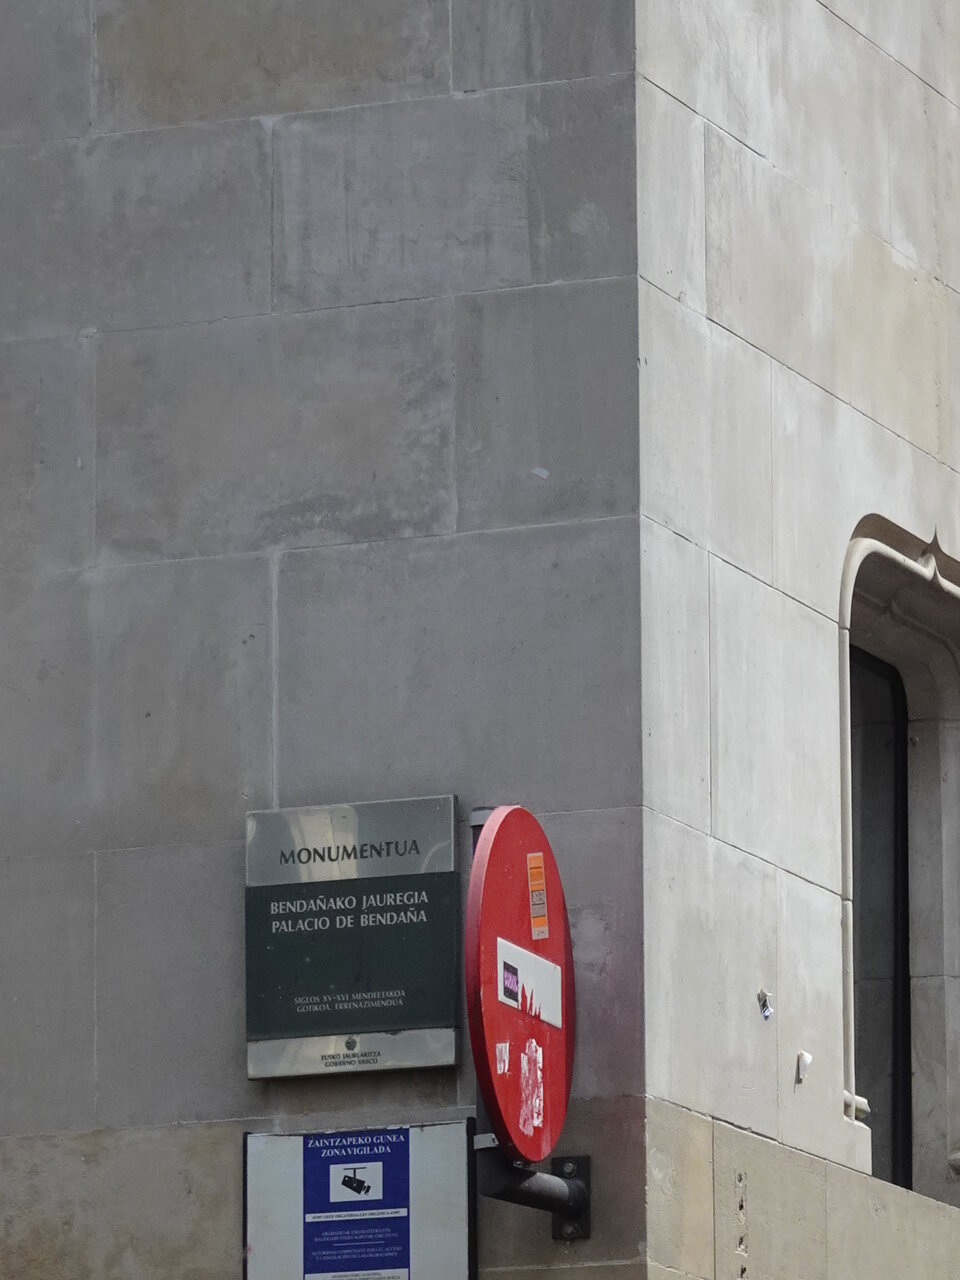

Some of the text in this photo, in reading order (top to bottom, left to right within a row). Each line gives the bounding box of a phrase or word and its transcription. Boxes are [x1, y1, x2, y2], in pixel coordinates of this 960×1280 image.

[279, 840, 421, 866] MONUMENTUA
[270, 891, 429, 915] BENDAÑAKO JAUREGIA
[272, 907, 427, 934] PALACIO DE BENDAÑA
[294, 995, 321, 1004] SIGLOS
[323, 993, 349, 1002] XV-XVI
[308, 1134, 405, 1148] ZAINTZAPEKO GUNEA
[321, 1145, 391, 1157] ZONA VIGILADA
